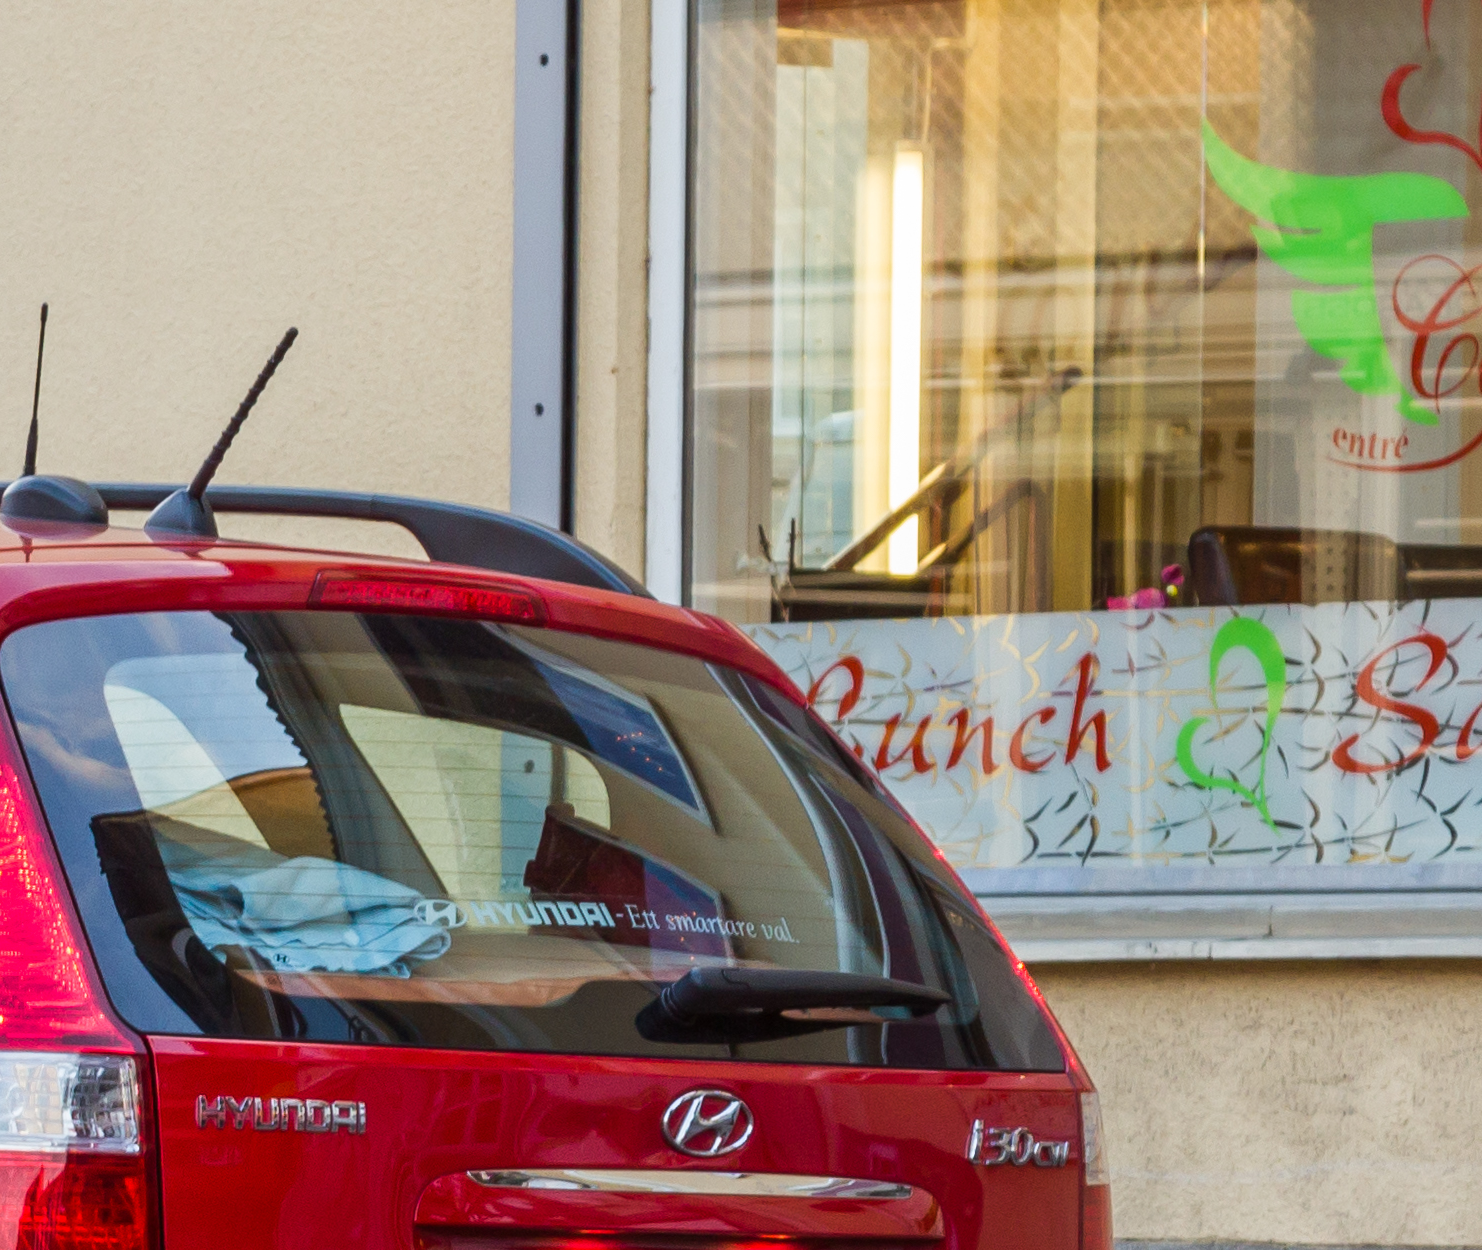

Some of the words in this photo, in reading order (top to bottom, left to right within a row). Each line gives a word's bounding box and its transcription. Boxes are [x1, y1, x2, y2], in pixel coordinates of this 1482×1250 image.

[1332, 426, 1409, 460] entré
[806, 651, 1112, 775] Lunch
[473, 901, 617, 928] HYUNDAI
[664, 911, 756, 940] smartare
[762, 916, 801, 944] val.
[195, 1094, 368, 1135] HYUNDAI
